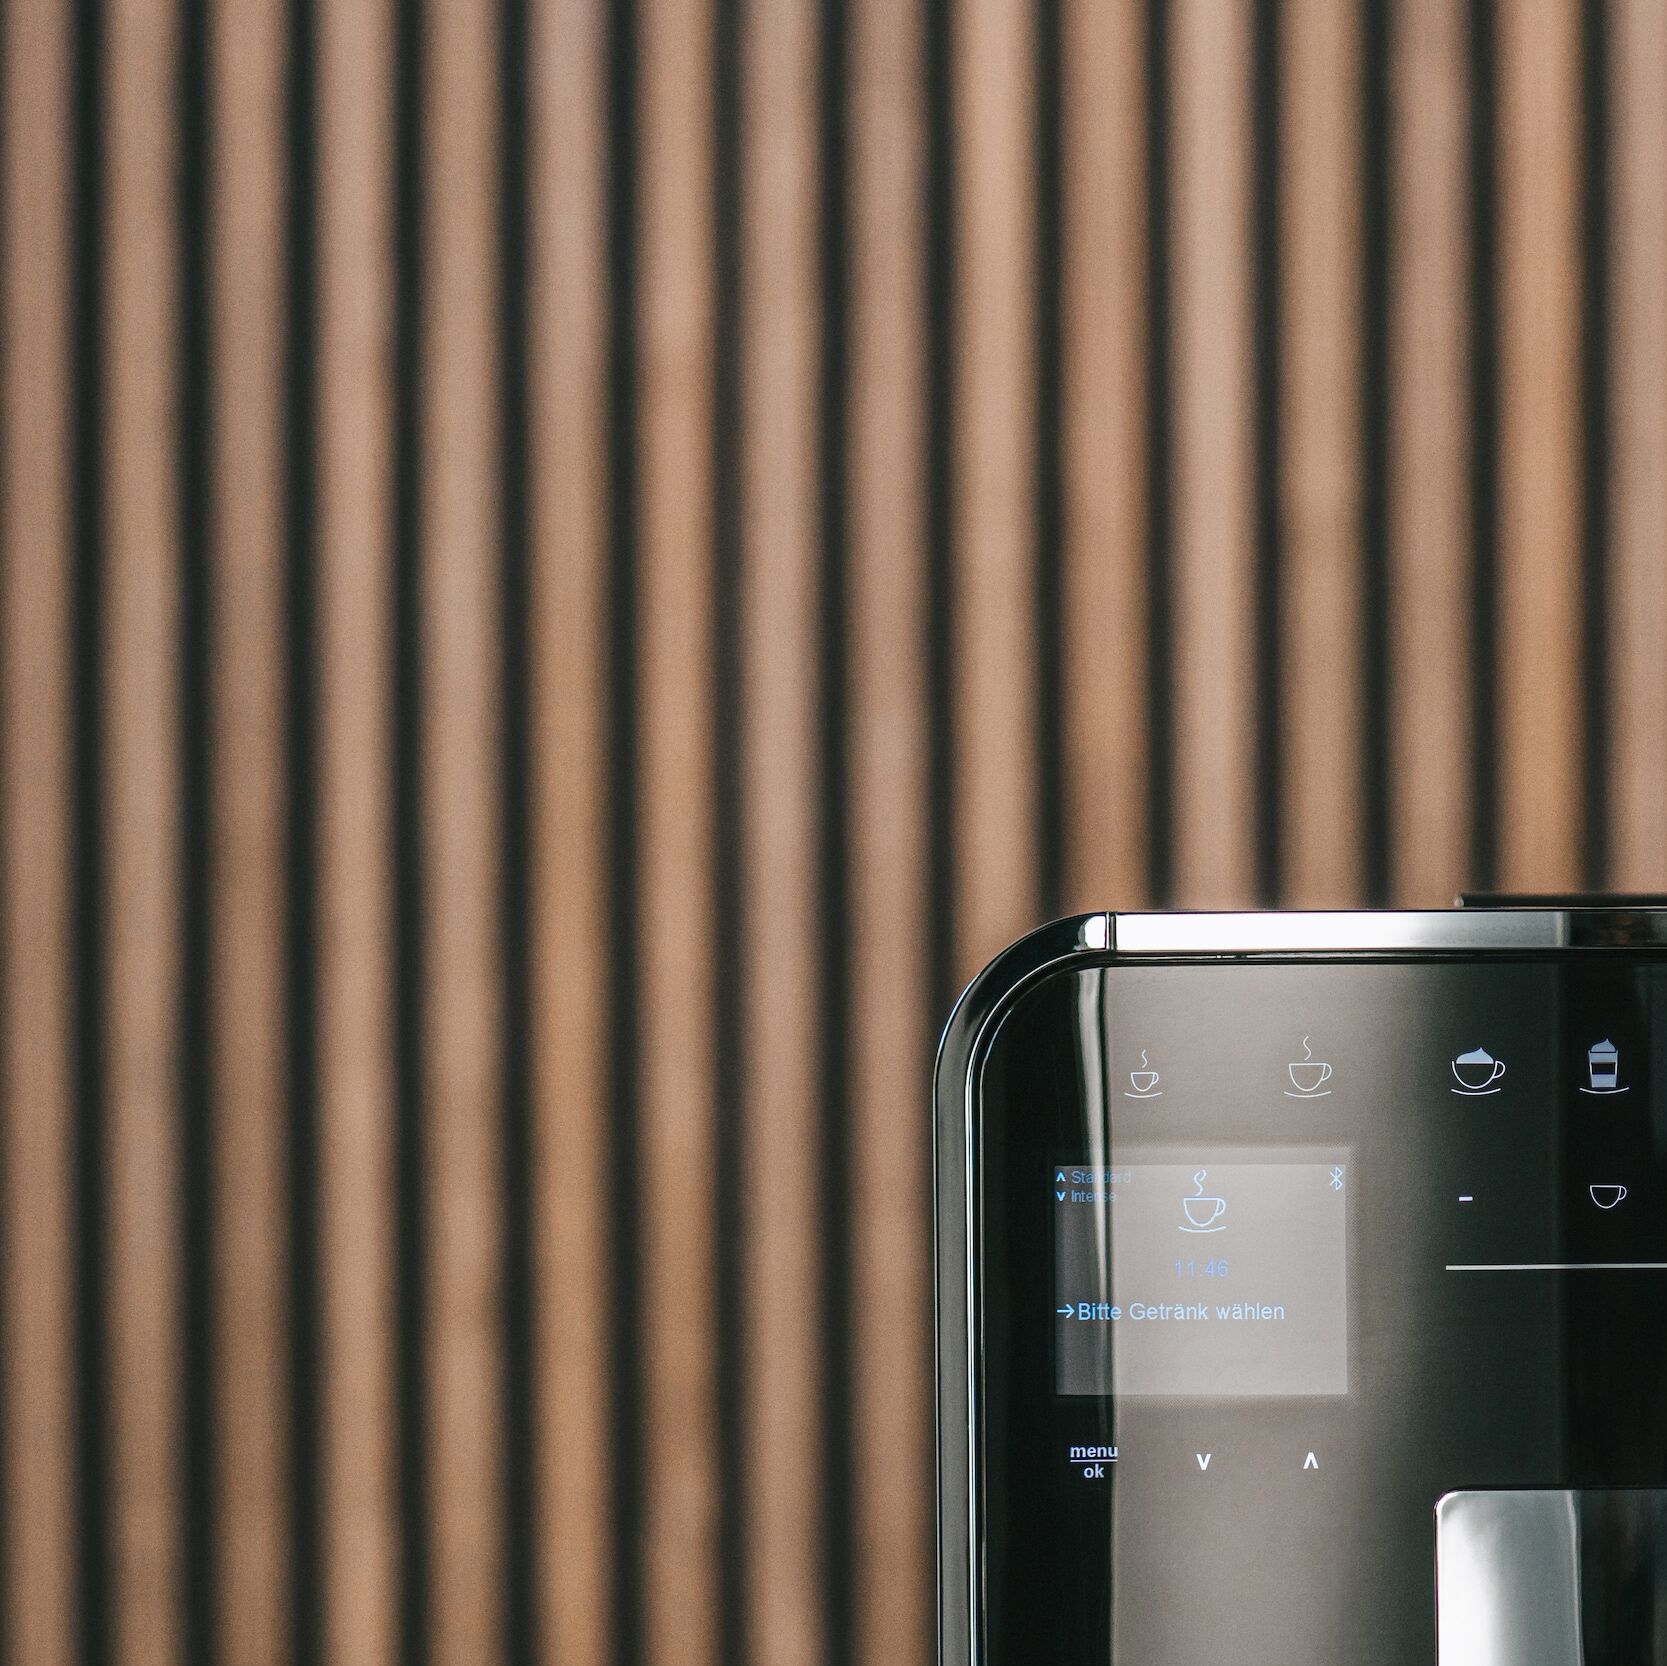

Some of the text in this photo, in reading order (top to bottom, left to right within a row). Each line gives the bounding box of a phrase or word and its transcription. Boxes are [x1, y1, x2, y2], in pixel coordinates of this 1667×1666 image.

[1174, 1260, 1228, 1277] 11:46
[1078, 1302, 1284, 1320] Bitte Getränk wählen
[1070, 1445, 1118, 1458] menu
[1084, 1464, 1104, 1478] ok
